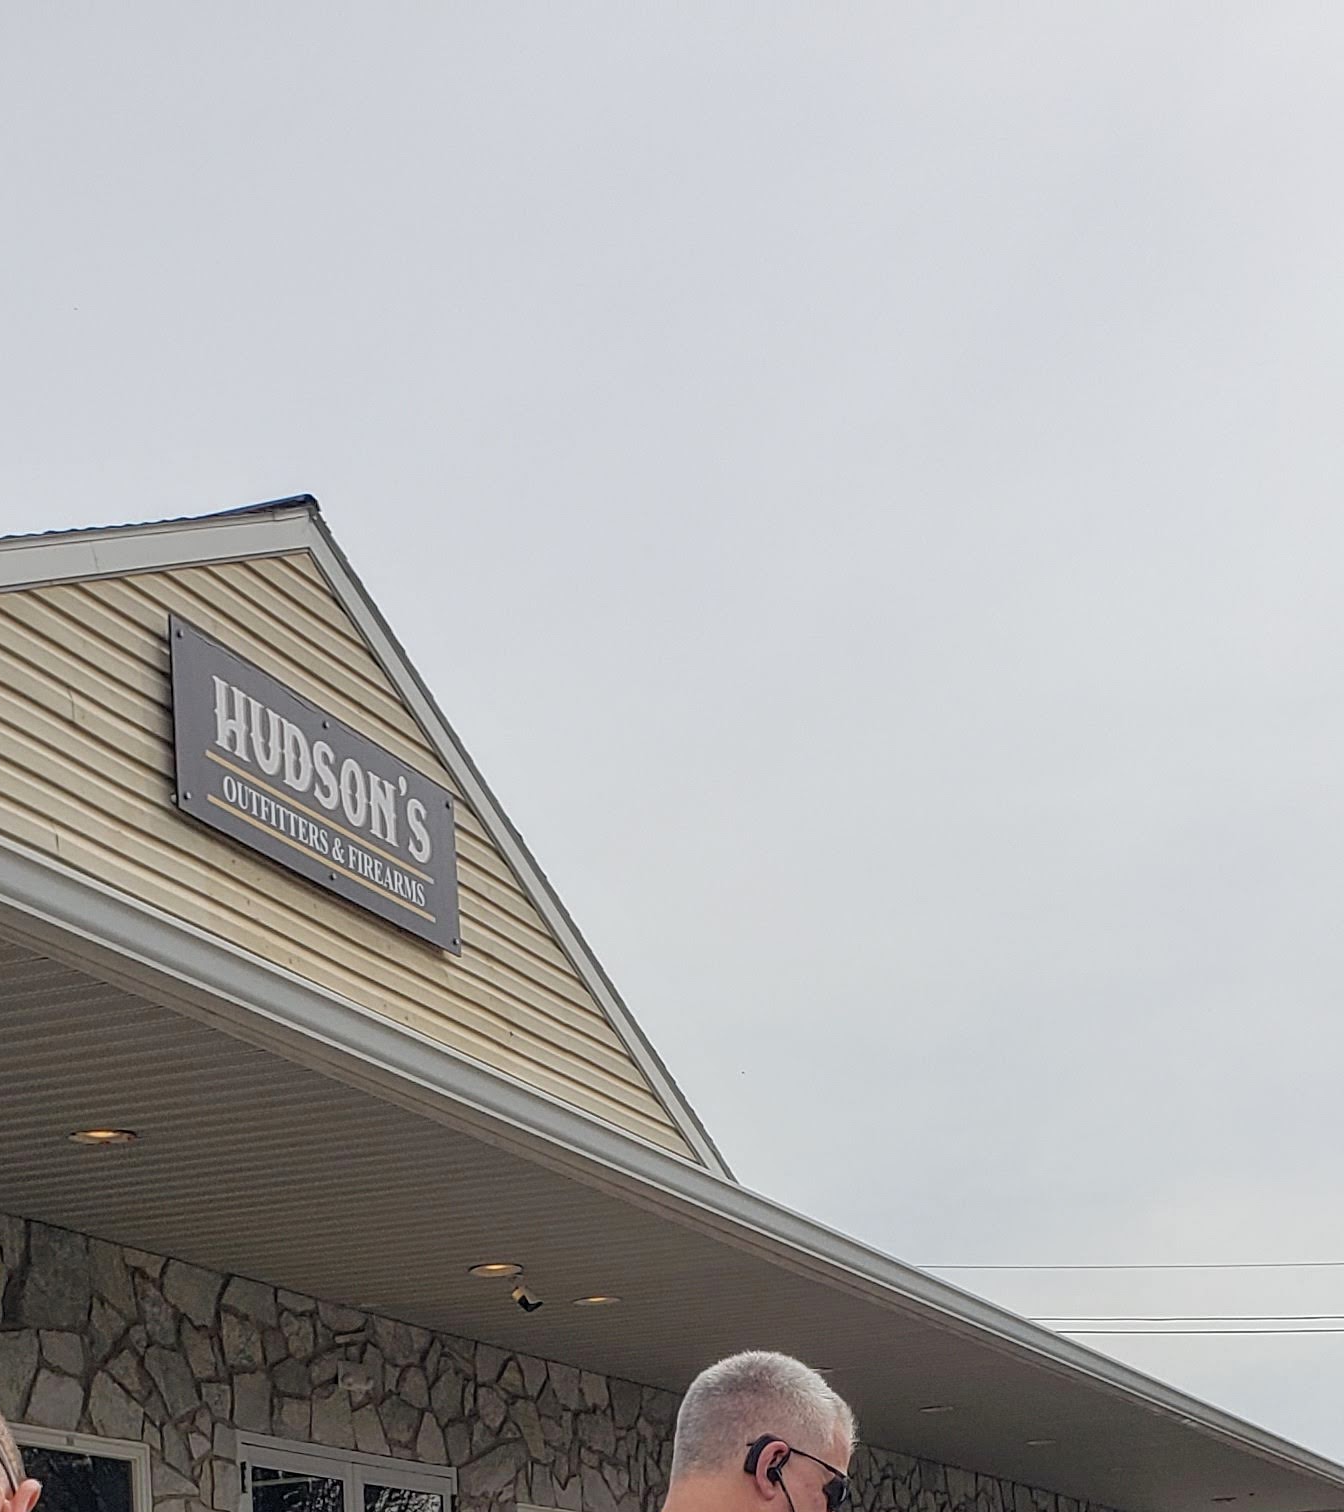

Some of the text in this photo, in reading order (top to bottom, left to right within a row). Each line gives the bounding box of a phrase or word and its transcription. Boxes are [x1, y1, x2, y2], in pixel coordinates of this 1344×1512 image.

[212, 674, 432, 864] HUDSON'S
[222, 775, 426, 907] OUTFITTERS & FIREARMS
